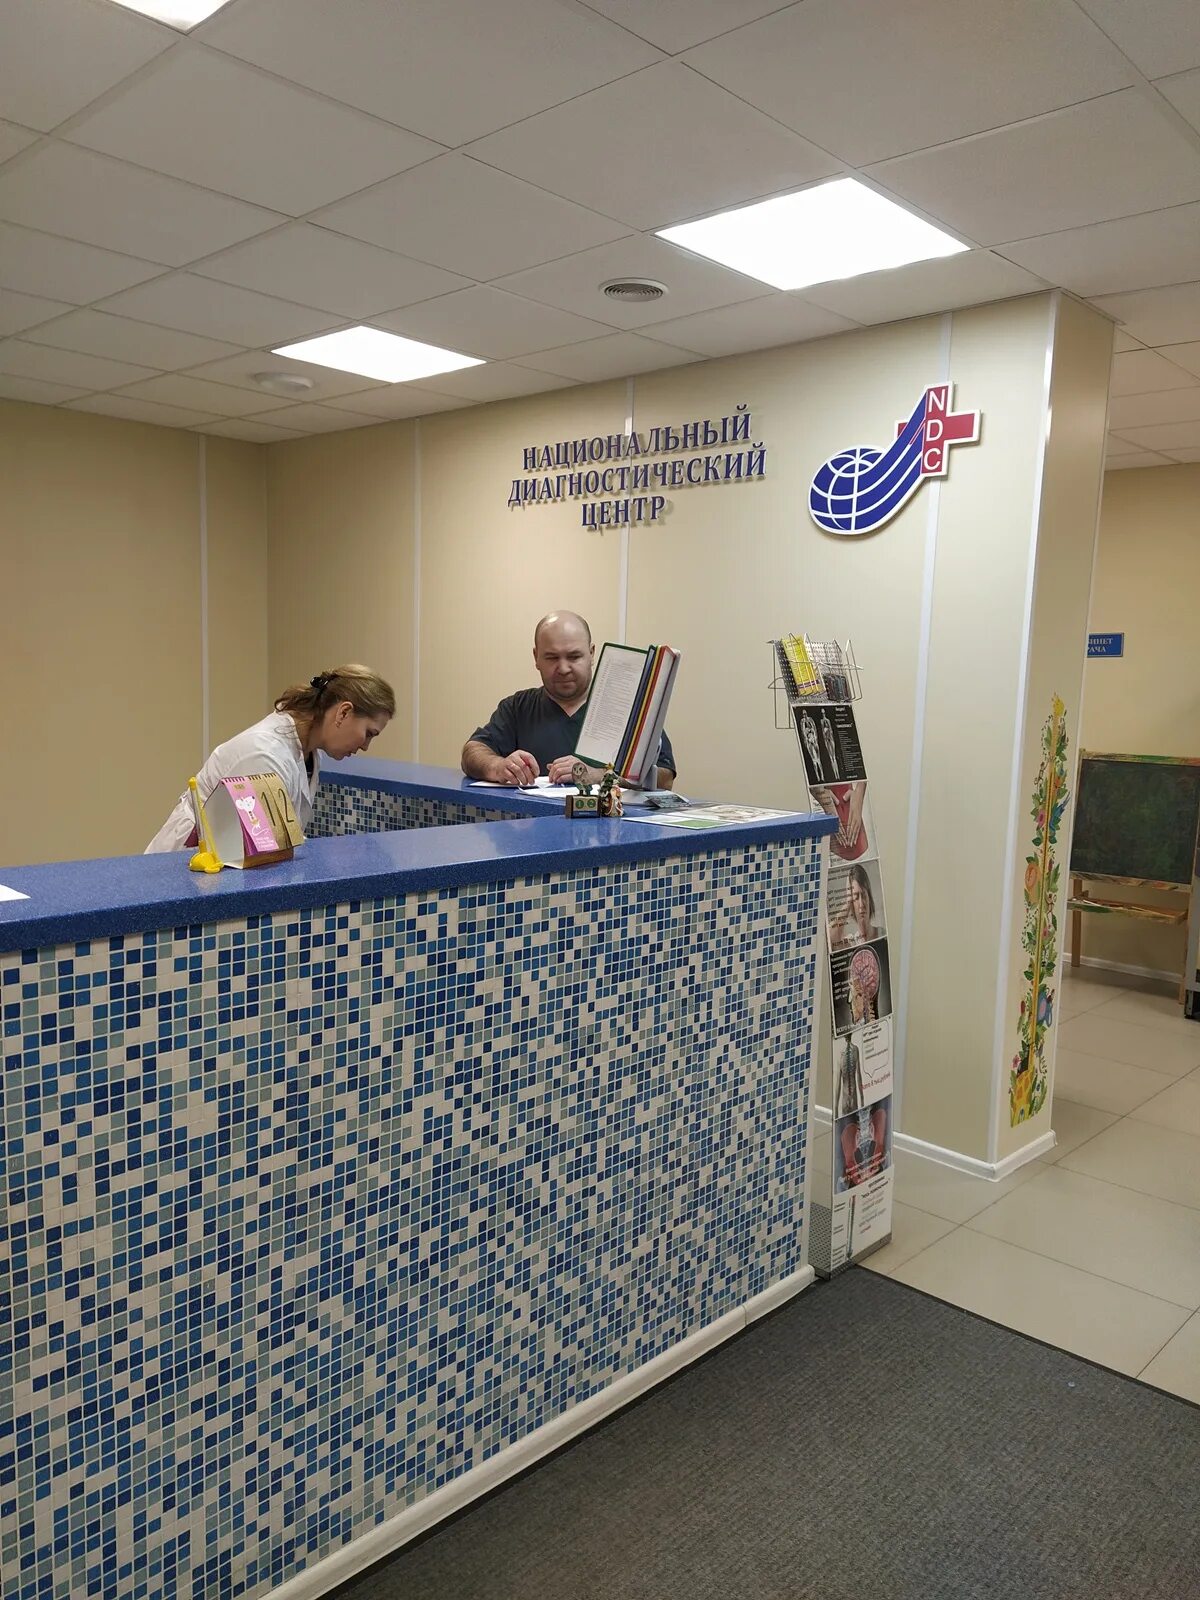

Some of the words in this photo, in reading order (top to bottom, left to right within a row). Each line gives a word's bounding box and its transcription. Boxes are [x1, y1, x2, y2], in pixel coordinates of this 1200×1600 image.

[523, 404, 751, 469] НАЦИОНАЛЬНЫЙ
[924, 388, 946, 470] NDC
[508, 441, 766, 508] ДИАГНОСТИЧЕСКИЙ
[581, 495, 665, 530] ЦЕНТР
